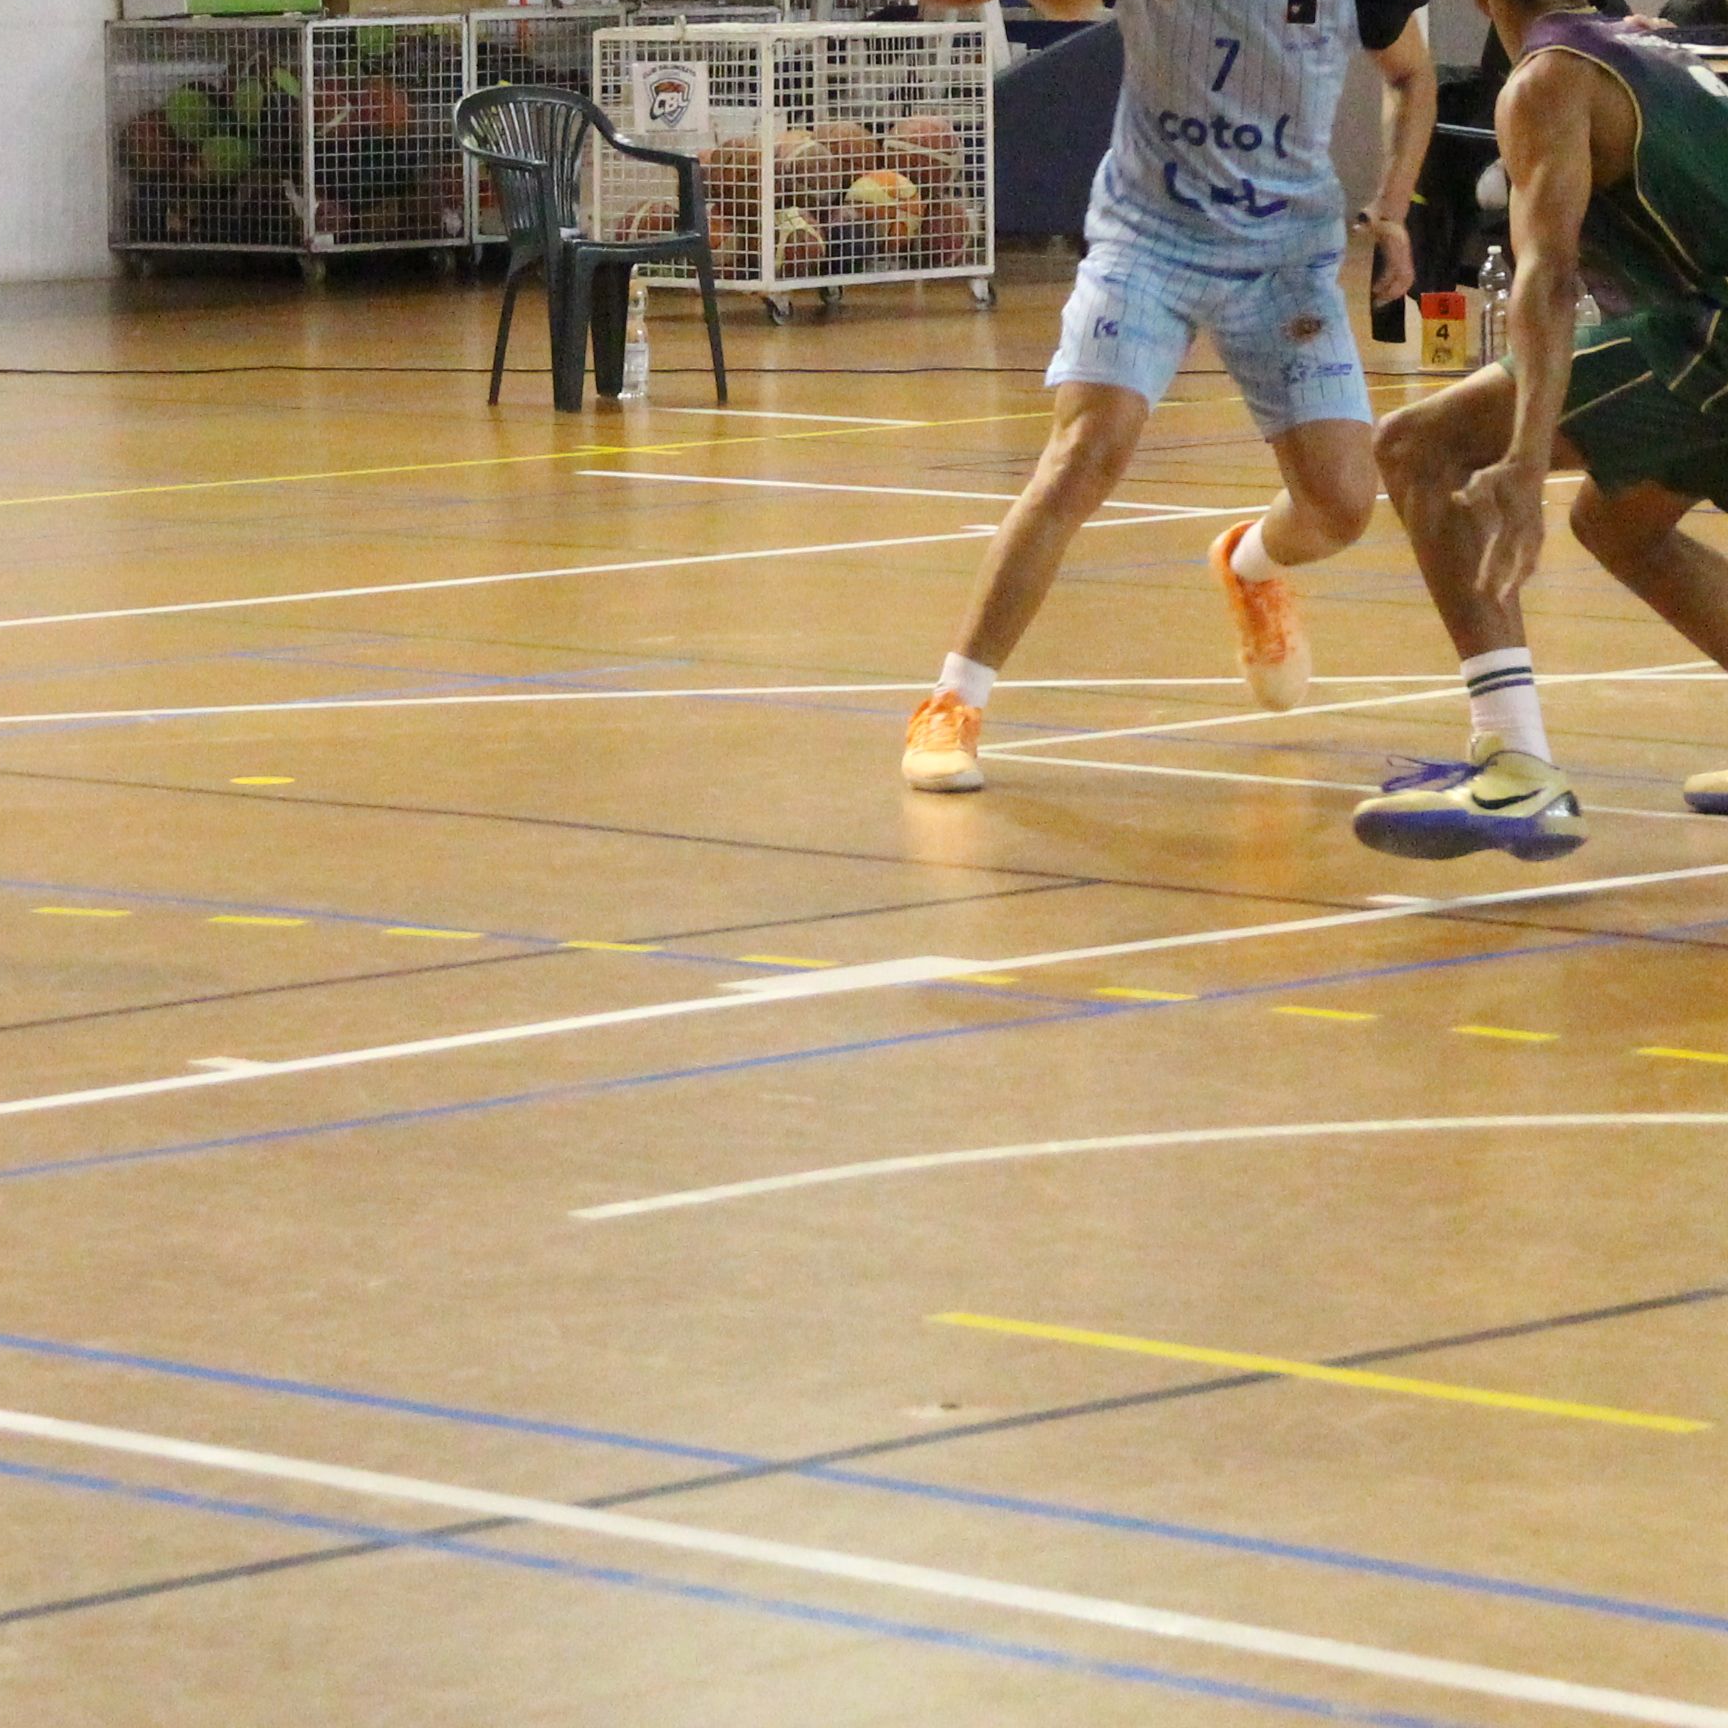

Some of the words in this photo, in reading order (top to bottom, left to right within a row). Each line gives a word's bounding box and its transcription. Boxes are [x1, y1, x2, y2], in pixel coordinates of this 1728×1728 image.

[1210, 37, 1242, 93] 7
[1158, 109, 1263, 152] coto
[1435, 323, 1450, 342] 4
